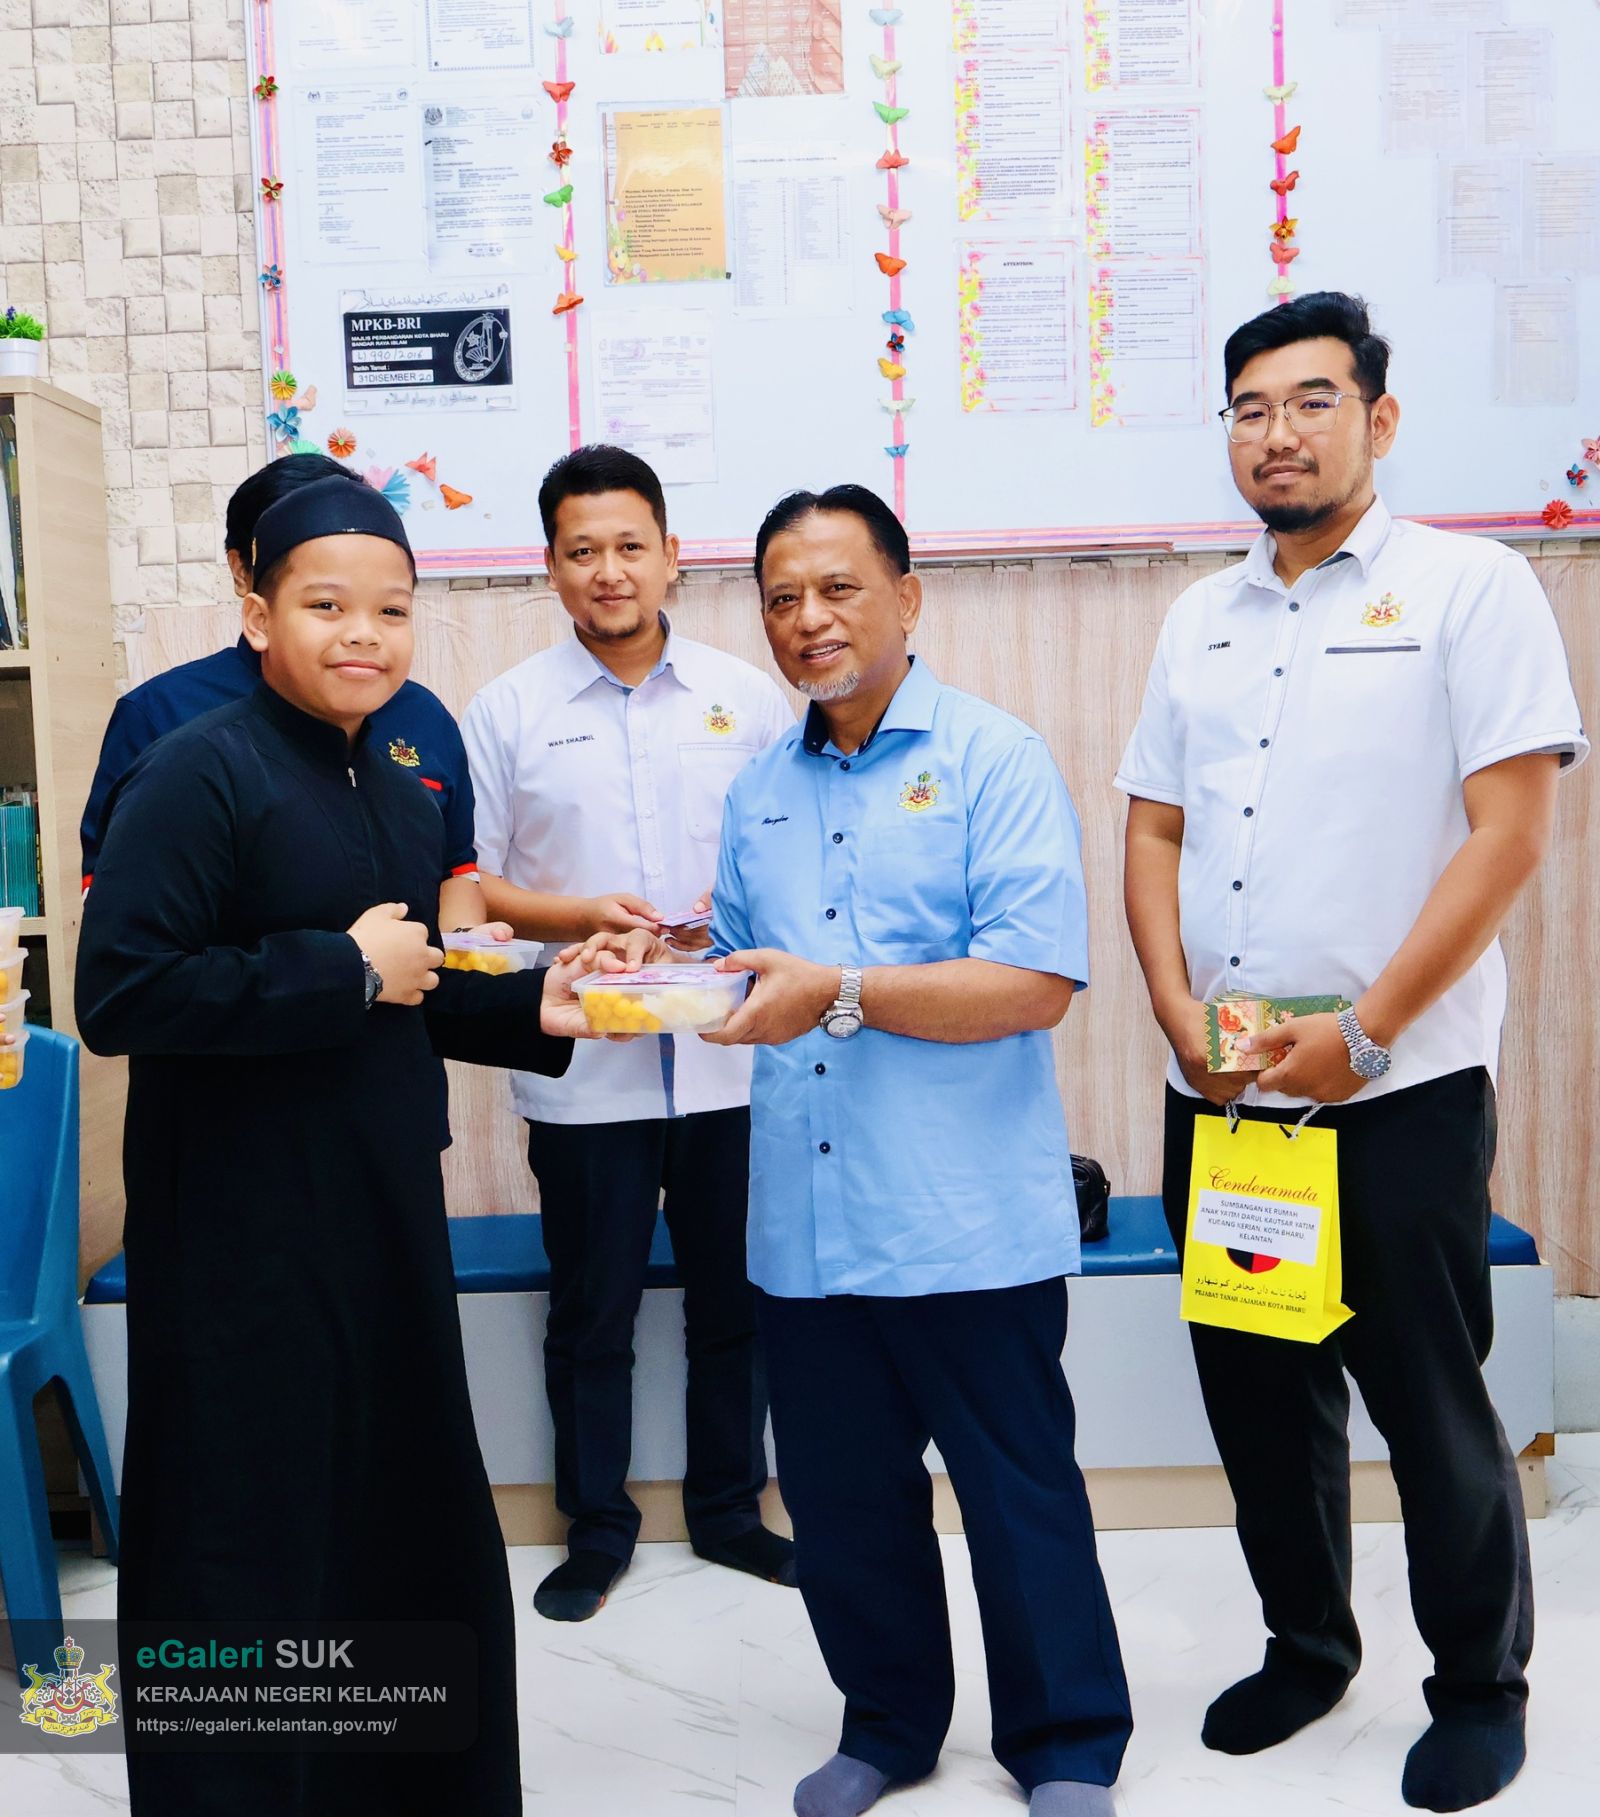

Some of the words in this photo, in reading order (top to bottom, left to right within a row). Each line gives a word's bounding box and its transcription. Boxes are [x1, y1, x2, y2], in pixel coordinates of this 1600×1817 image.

[351, 316, 422, 332] MPKB-BRI
[548, 738, 564, 748] WAN
[1208, 1166, 1318, 1202] Cenderamata
[1201, 1207, 1219, 1215] ANAK
[1220, 1210, 1240, 1218] YATIM
[1241, 1213, 1262, 1222] DARUL
[1264, 1217, 1293, 1227] KAUTSAR
[1221, 1200, 1263, 1213] SUMBANGAN
[1274, 1208, 1298, 1218] RUMAH
[1240, 1233, 1273, 1244] KELANTAN
[1264, 1226, 1280, 1235] KOTA
[1195, 1289, 1218, 1299] PEJABAT
[1220, 1293, 1239, 1302] TANAH
[1240, 1296, 1266, 1307] JAJAHAN
[1268, 1302, 1284, 1310] KOTA
[1286, 1304, 1306, 1314] BHARU
